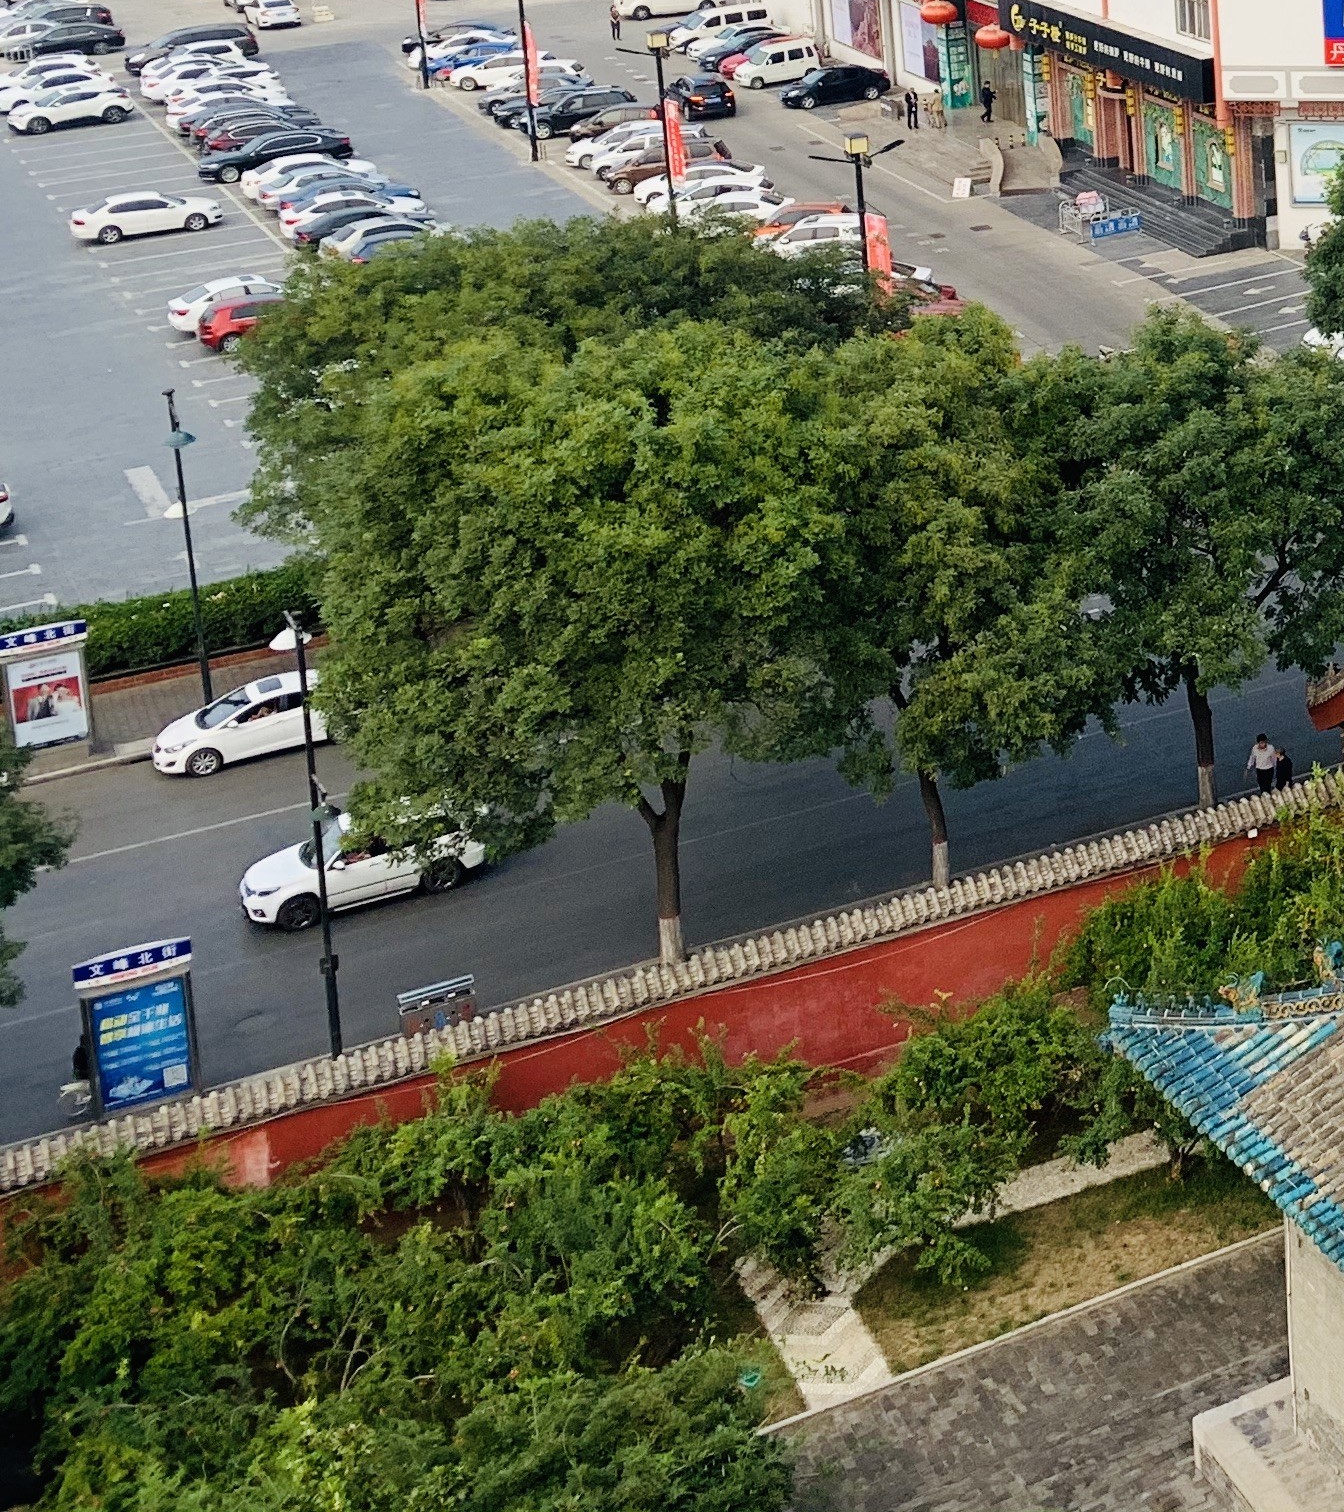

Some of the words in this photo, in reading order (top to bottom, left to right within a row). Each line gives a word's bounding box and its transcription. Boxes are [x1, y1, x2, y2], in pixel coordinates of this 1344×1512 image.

[4, 624, 76, 648] 文峰北街
[89, 943, 178, 978] 文峰北街
